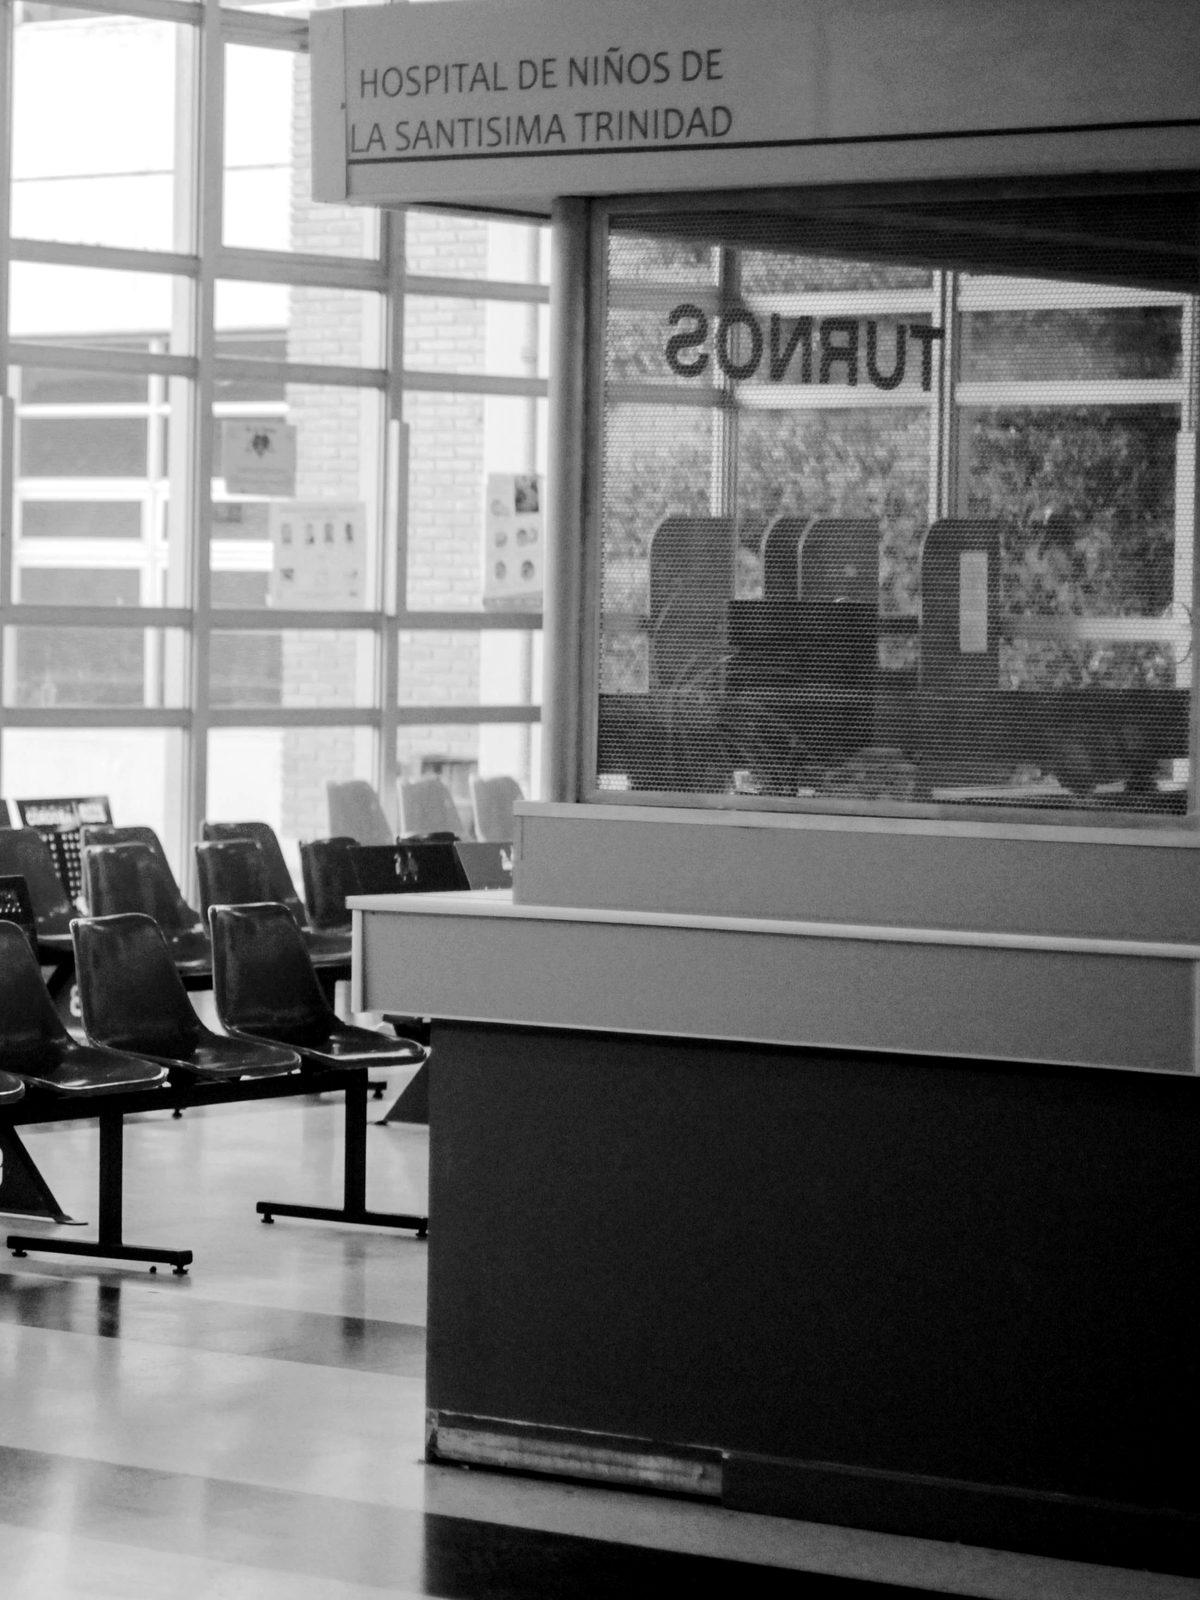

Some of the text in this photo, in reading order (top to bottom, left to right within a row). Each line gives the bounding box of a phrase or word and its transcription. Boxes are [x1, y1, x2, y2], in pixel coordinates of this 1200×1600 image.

[359, 46, 724, 99] HOSPITAL DE NIÑOS DE
[350, 105, 734, 154] LA SANTISIMA TRINIDAD
